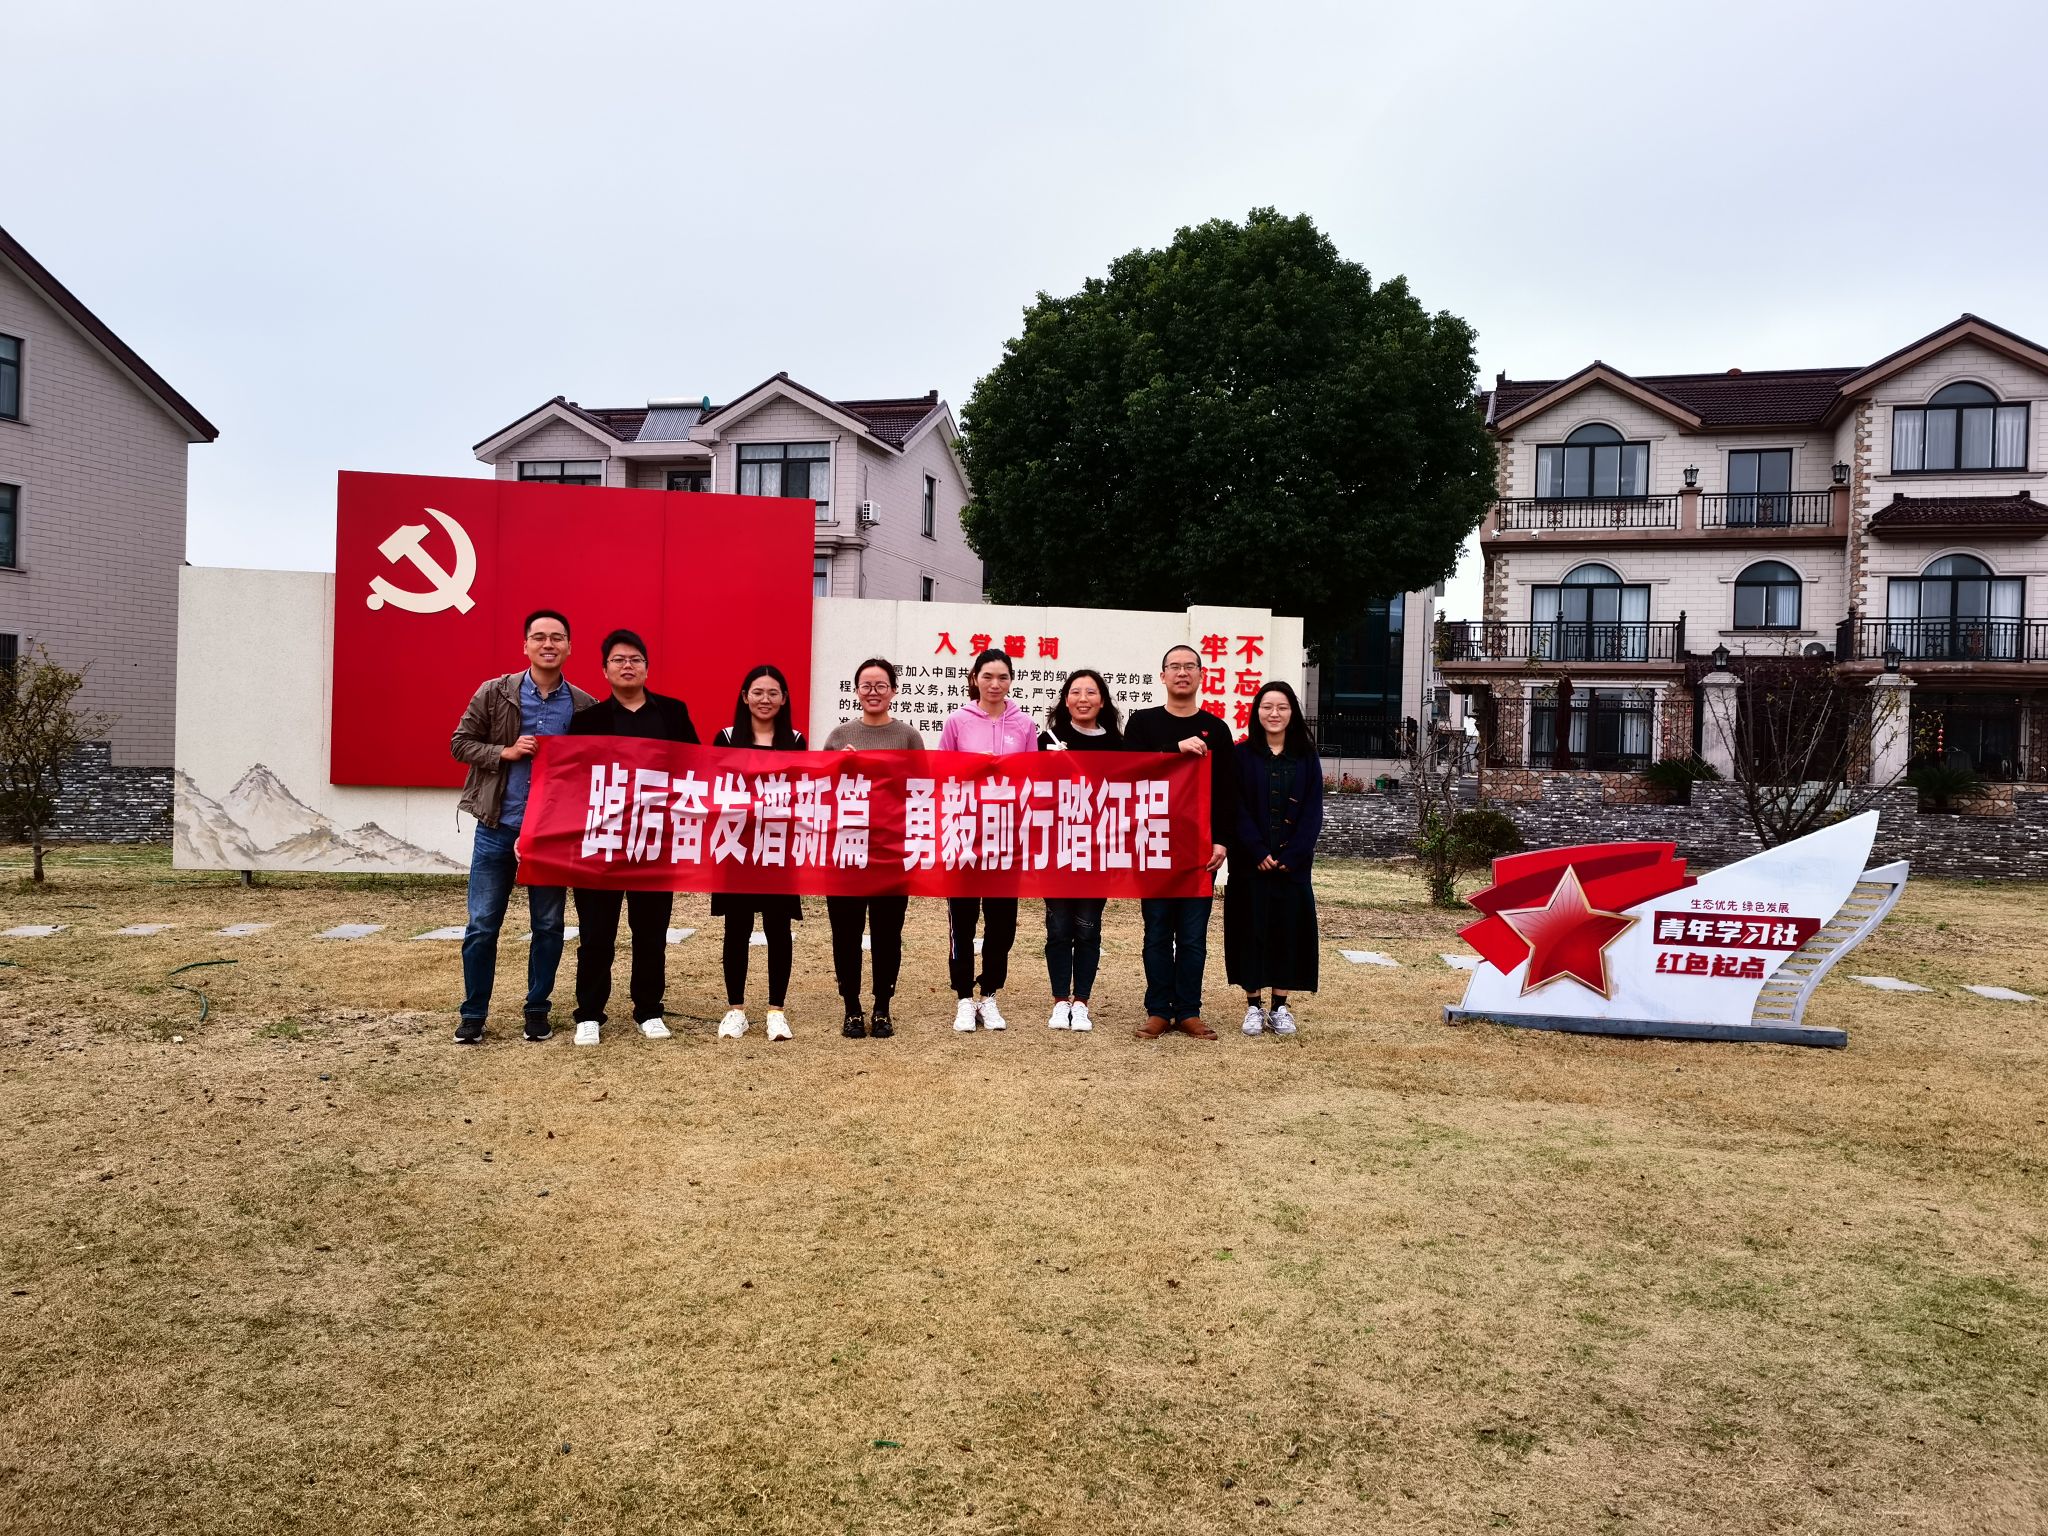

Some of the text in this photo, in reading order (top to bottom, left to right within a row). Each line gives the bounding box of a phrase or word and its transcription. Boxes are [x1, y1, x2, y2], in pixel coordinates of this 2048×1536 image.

[934, 632, 1059, 660] 入党誓词
[581, 762, 1172, 872] 踔厉奋发谱新篇 勇毅前行踏征程
[1691, 899, 1790, 914] 生态优先 绿色发展
[1658, 918, 1799, 946] 青年学习社
[1655, 952, 1766, 979] 红色起点
